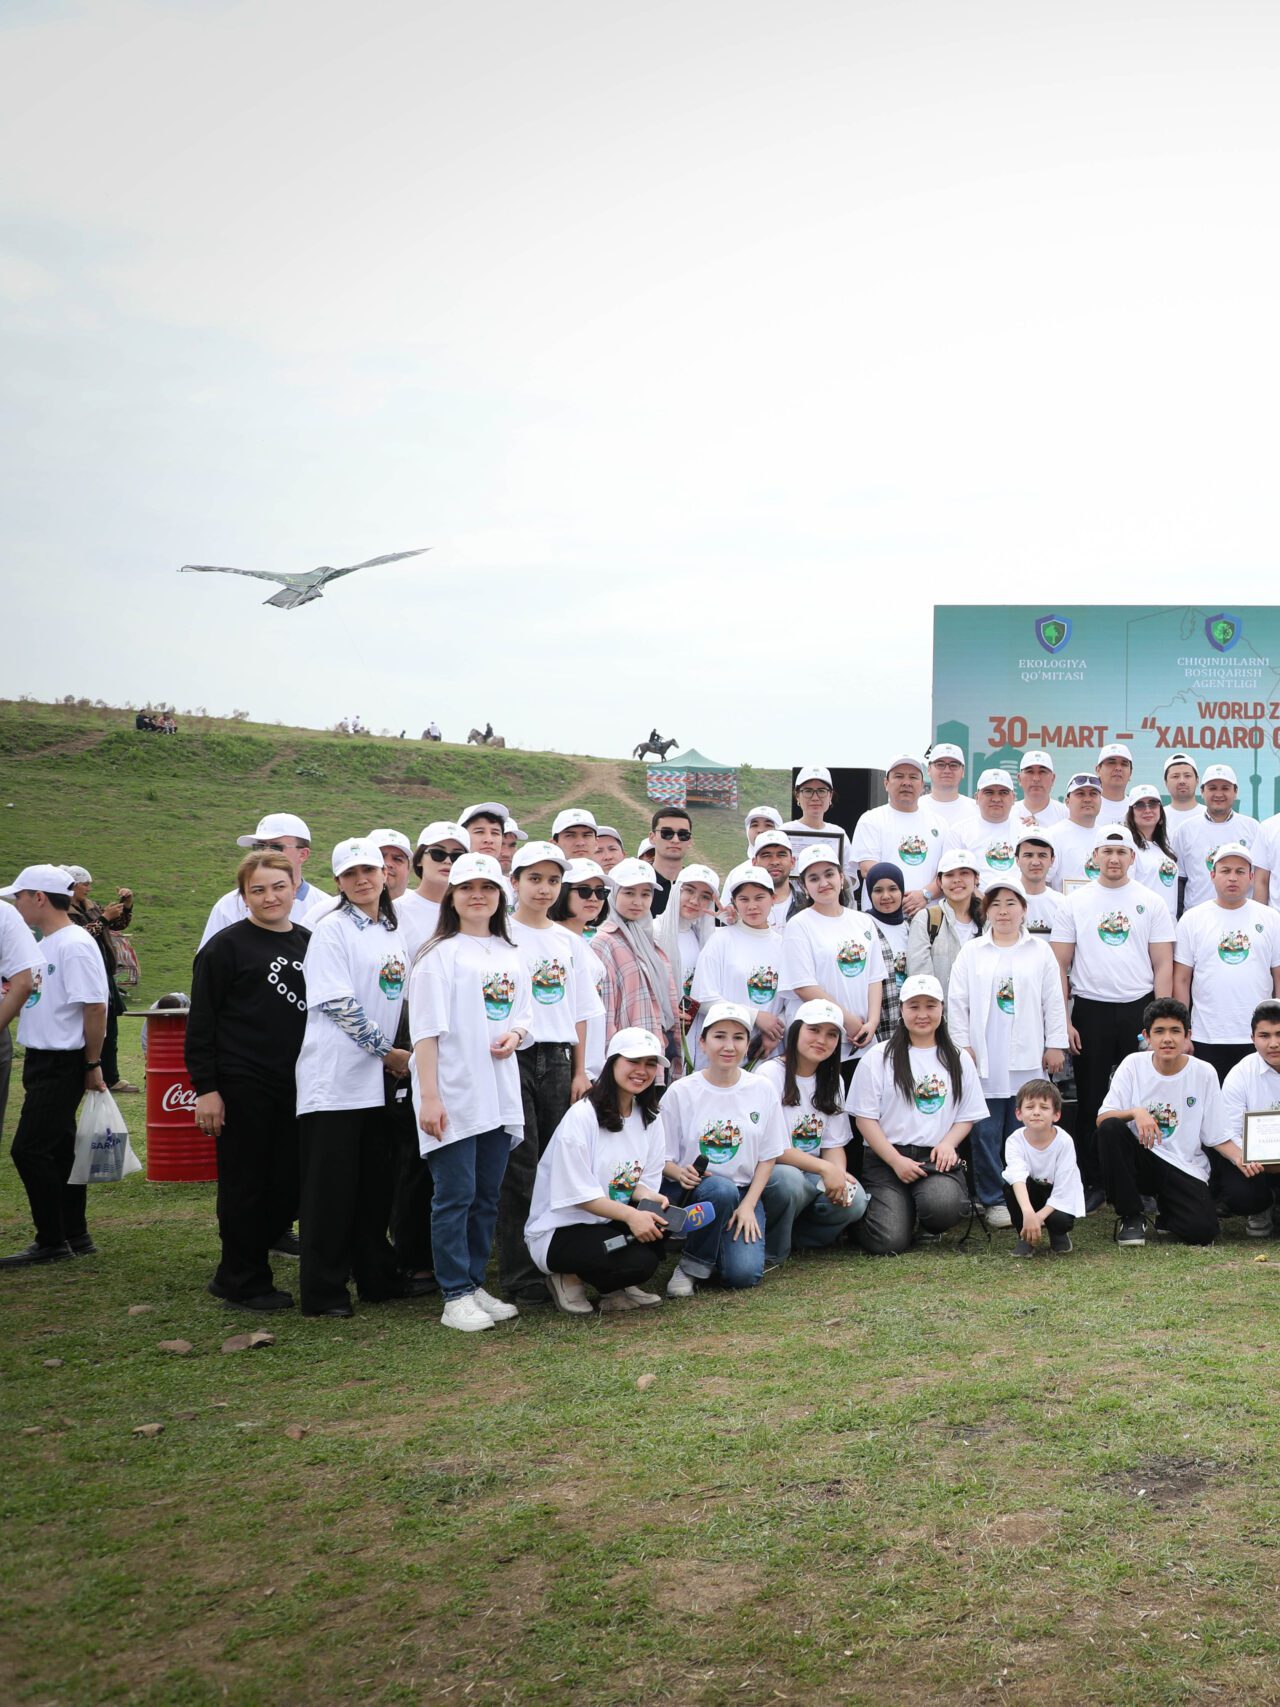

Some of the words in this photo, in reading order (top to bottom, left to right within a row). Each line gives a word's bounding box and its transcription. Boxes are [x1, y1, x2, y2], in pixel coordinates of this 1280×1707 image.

[1018, 659, 1088, 669] EKOLOGIYA
[1177, 657, 1270, 667] CHIQINDILARNI
[1184, 668, 1262, 679] BOSHQARISH
[1192, 679, 1257, 688] AGENTLIGI
[1198, 701, 1265, 720] WORLD
[987, 715, 1109, 748] 30-MART
